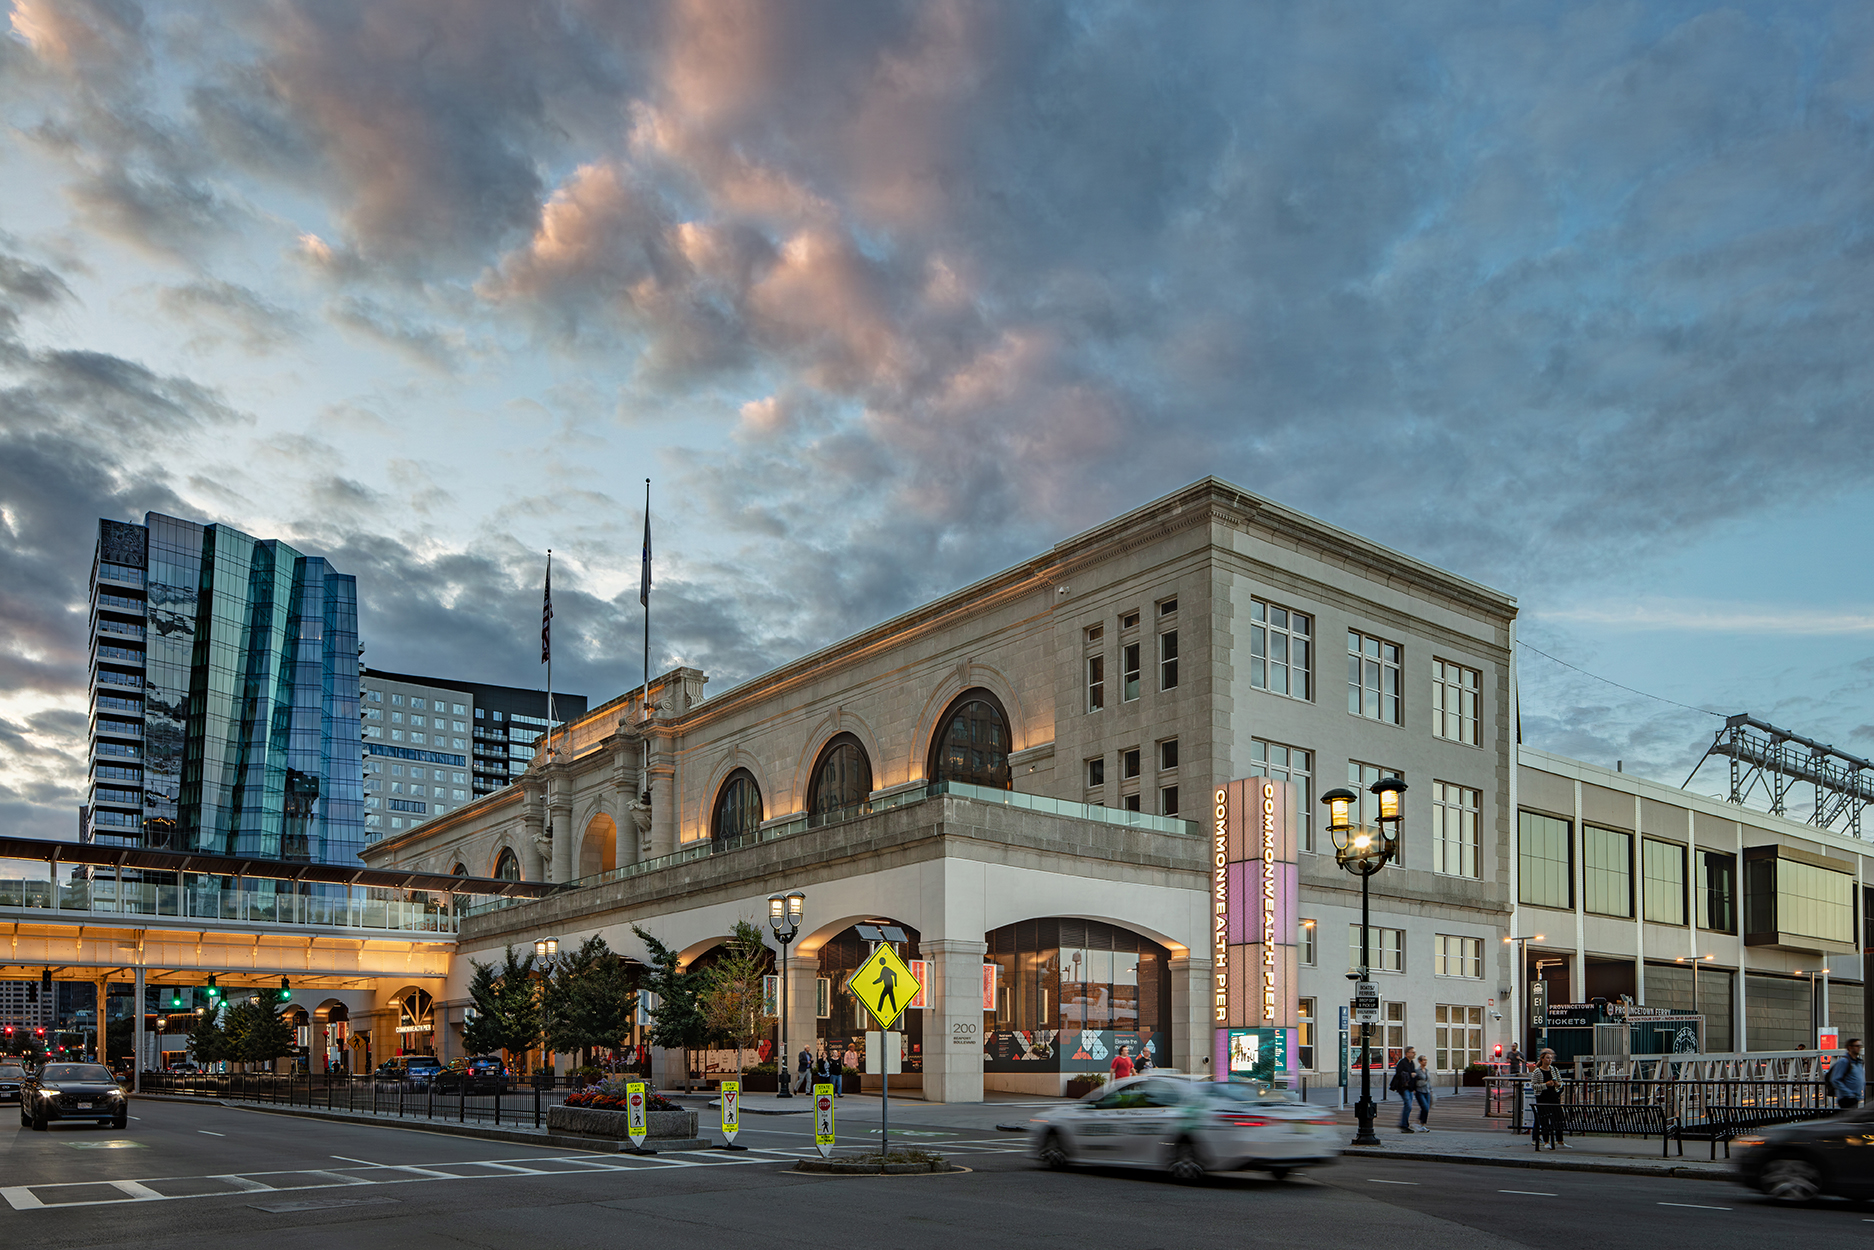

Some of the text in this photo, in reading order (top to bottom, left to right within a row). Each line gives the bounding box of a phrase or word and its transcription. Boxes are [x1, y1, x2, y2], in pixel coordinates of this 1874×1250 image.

[1215, 789, 1227, 1021] COMMONWEALTH PIER
[1263, 783, 1275, 1020] COMMONWEALTH PIER
[1534, 997, 1542, 1006] E1
[1655, 1008, 1671, 1016] FERRY
[1533, 1015, 1543, 1025] E6
[953, 1023, 977, 1034] 200
